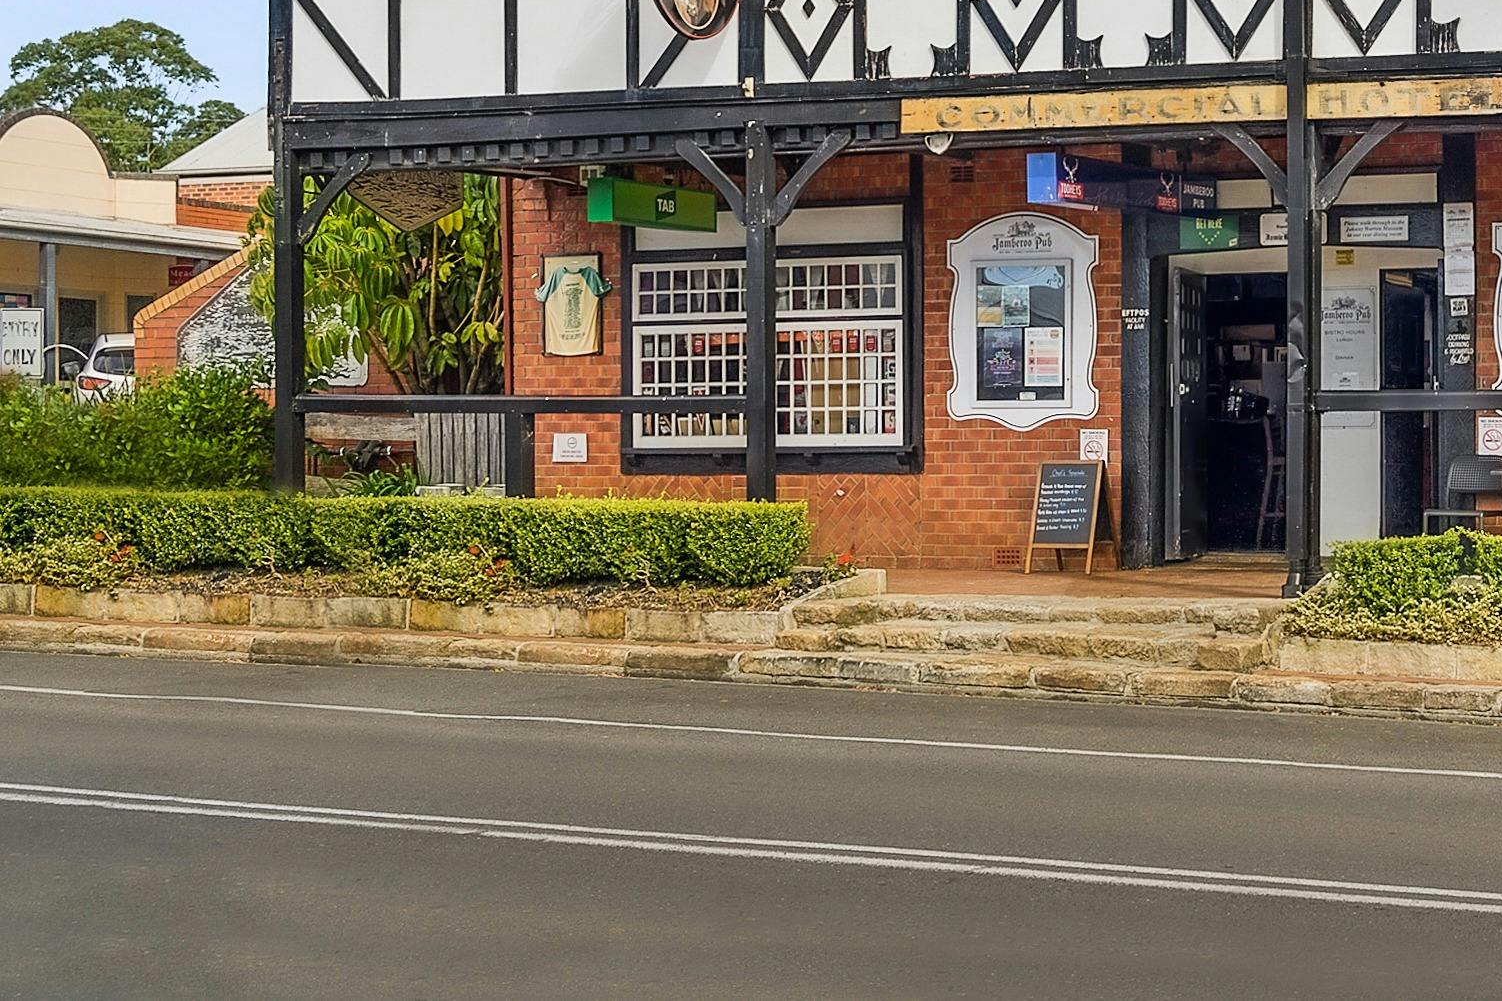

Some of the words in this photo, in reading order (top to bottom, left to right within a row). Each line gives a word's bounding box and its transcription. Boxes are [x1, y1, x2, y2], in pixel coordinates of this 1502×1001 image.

[1183, 184, 1215, 197] JAMBEROO
[657, 198, 675, 213] TAB
[1193, 198, 1205, 209] PUB
[992, 238, 1032, 252] Jamberoo
[1036, 236, 1053, 250] Pub
[1121, 308, 1149, 317] EFTPOS
[1356, 308, 1372, 321] Pub
[3, 348, 37, 366] ONLY
